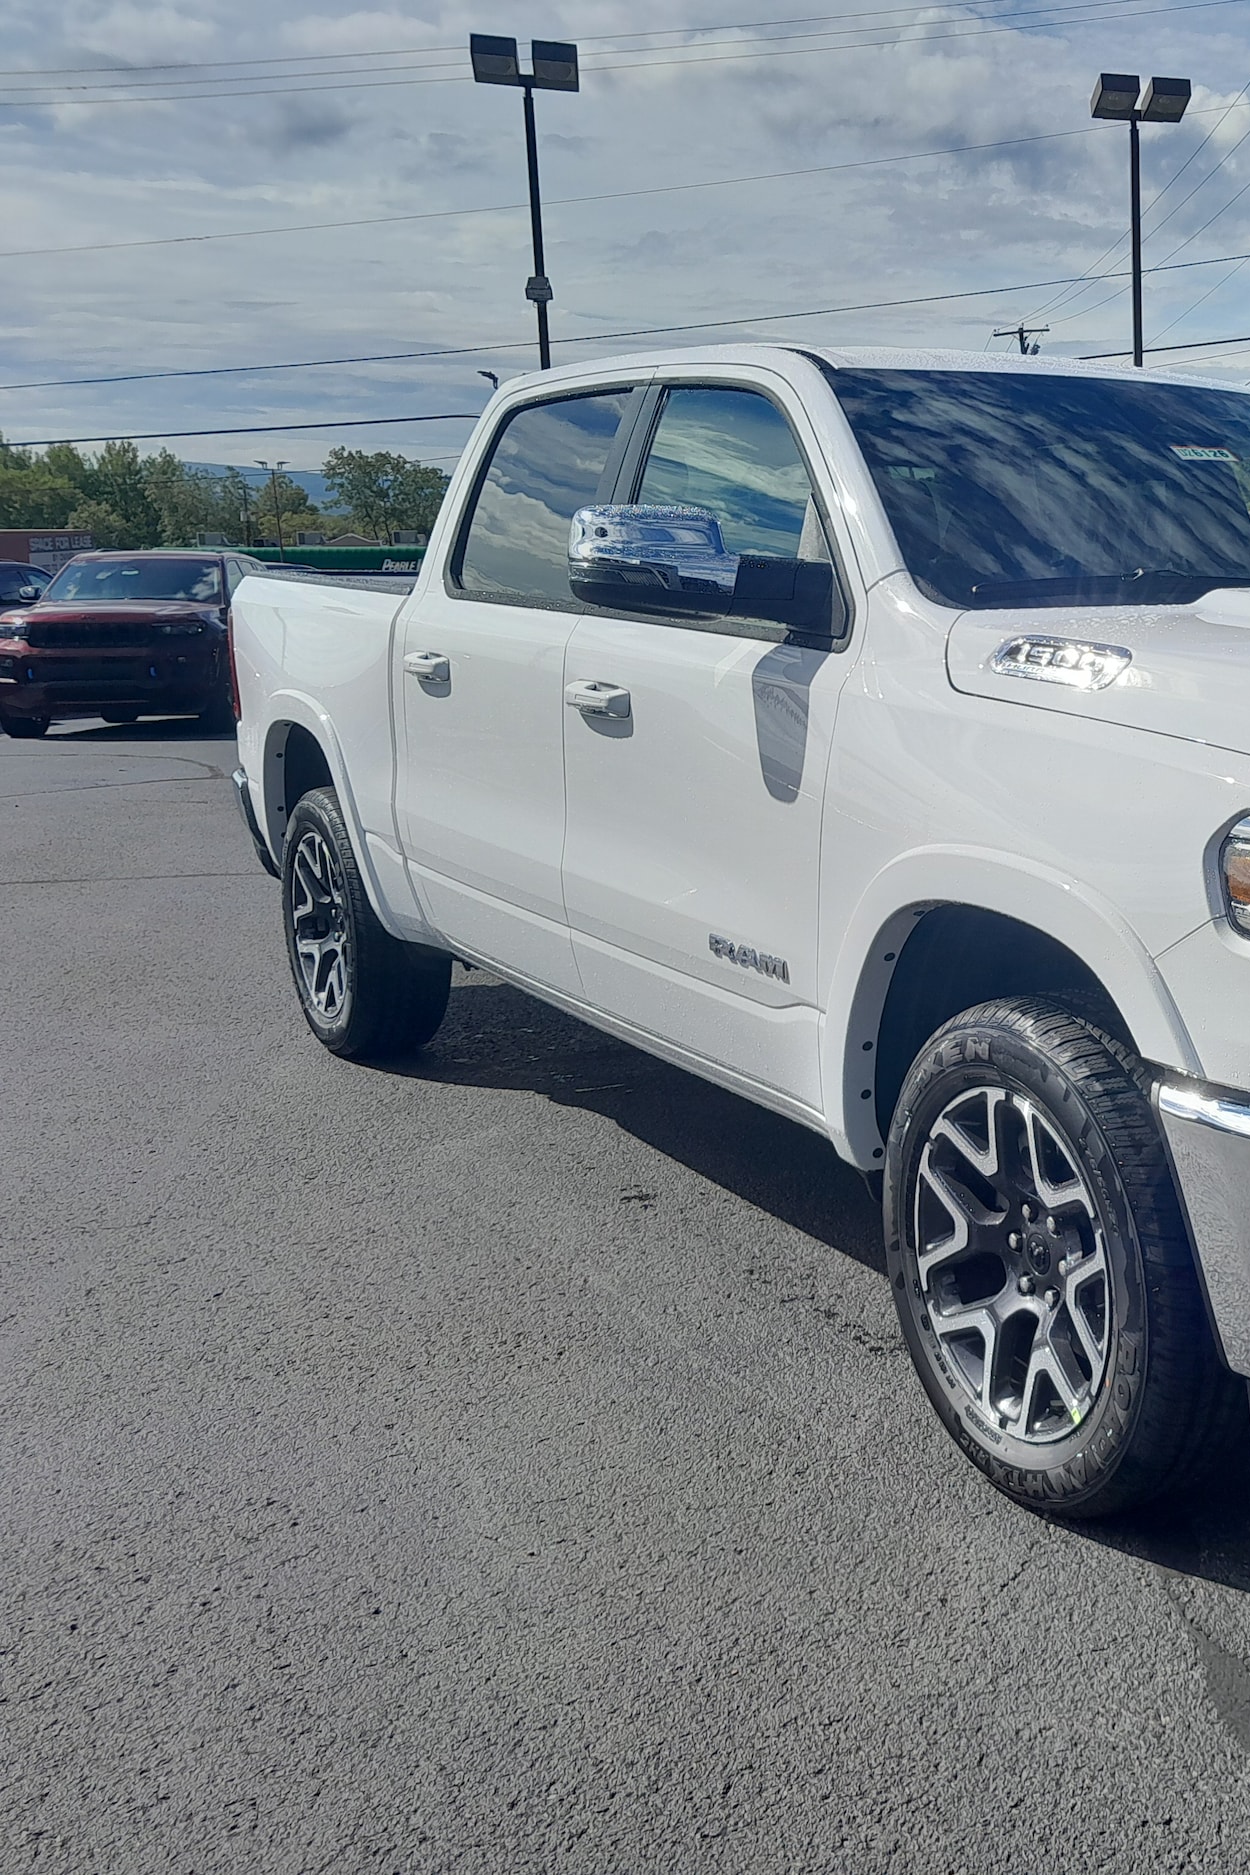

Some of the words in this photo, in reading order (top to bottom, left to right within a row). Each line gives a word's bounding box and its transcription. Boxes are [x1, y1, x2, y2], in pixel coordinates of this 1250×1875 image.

[55, 536, 70, 550] FOR
[71, 534, 93, 549] LEASE
[708, 932, 791, 985] RAM
